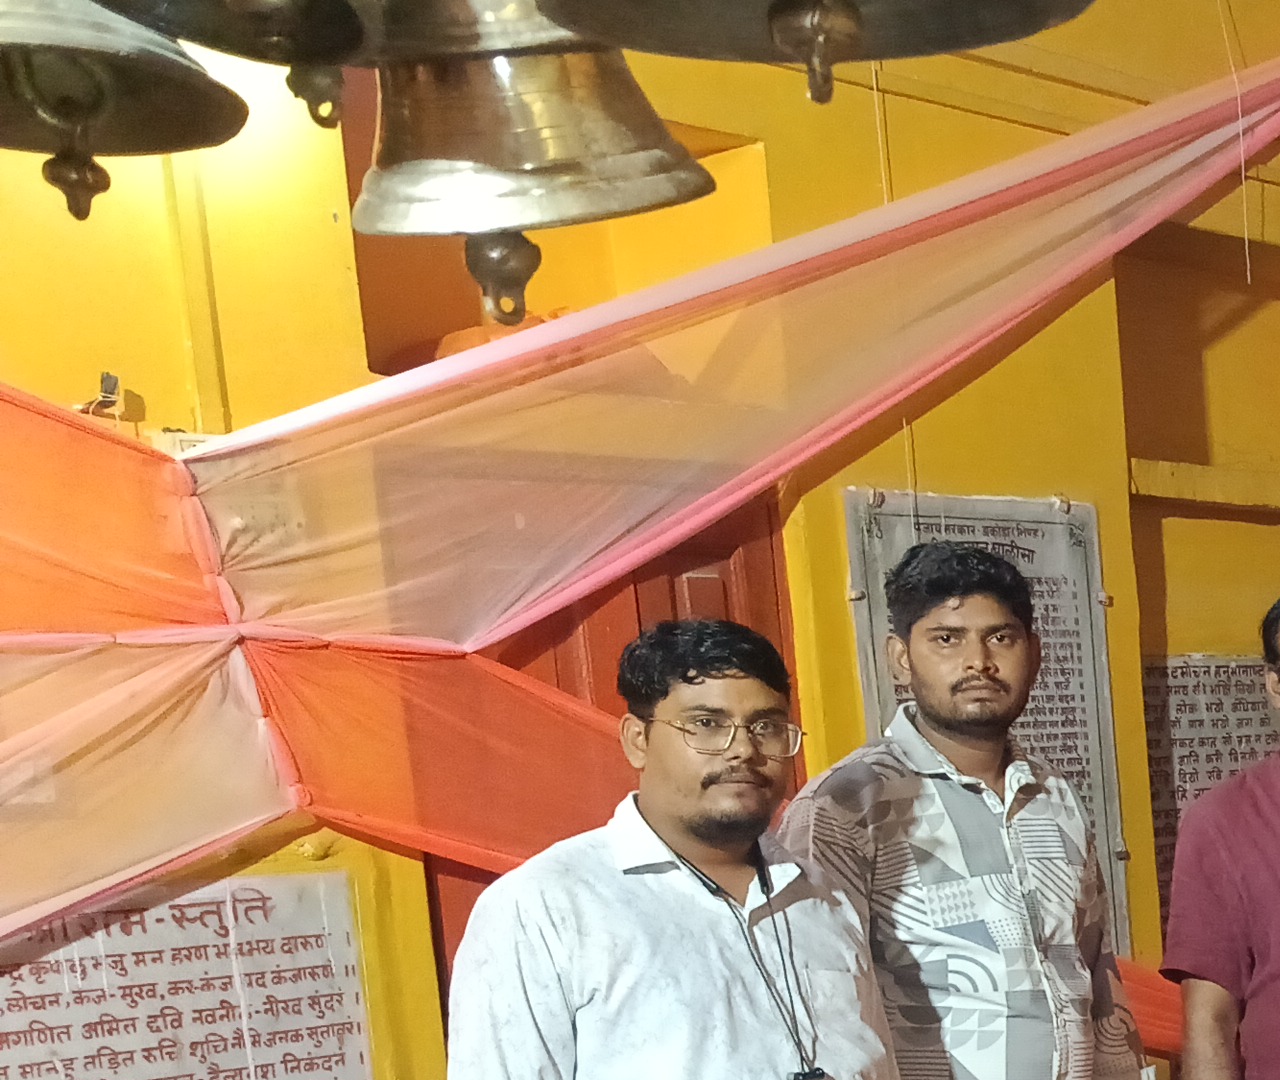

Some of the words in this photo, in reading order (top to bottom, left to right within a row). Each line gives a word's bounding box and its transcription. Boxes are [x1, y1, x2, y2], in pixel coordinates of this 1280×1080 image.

[1214, 664, 1265, 682] हनुमानाष्ट
[131, 950, 165, 968] मन
[82, 1013, 139, 1039] अमित
